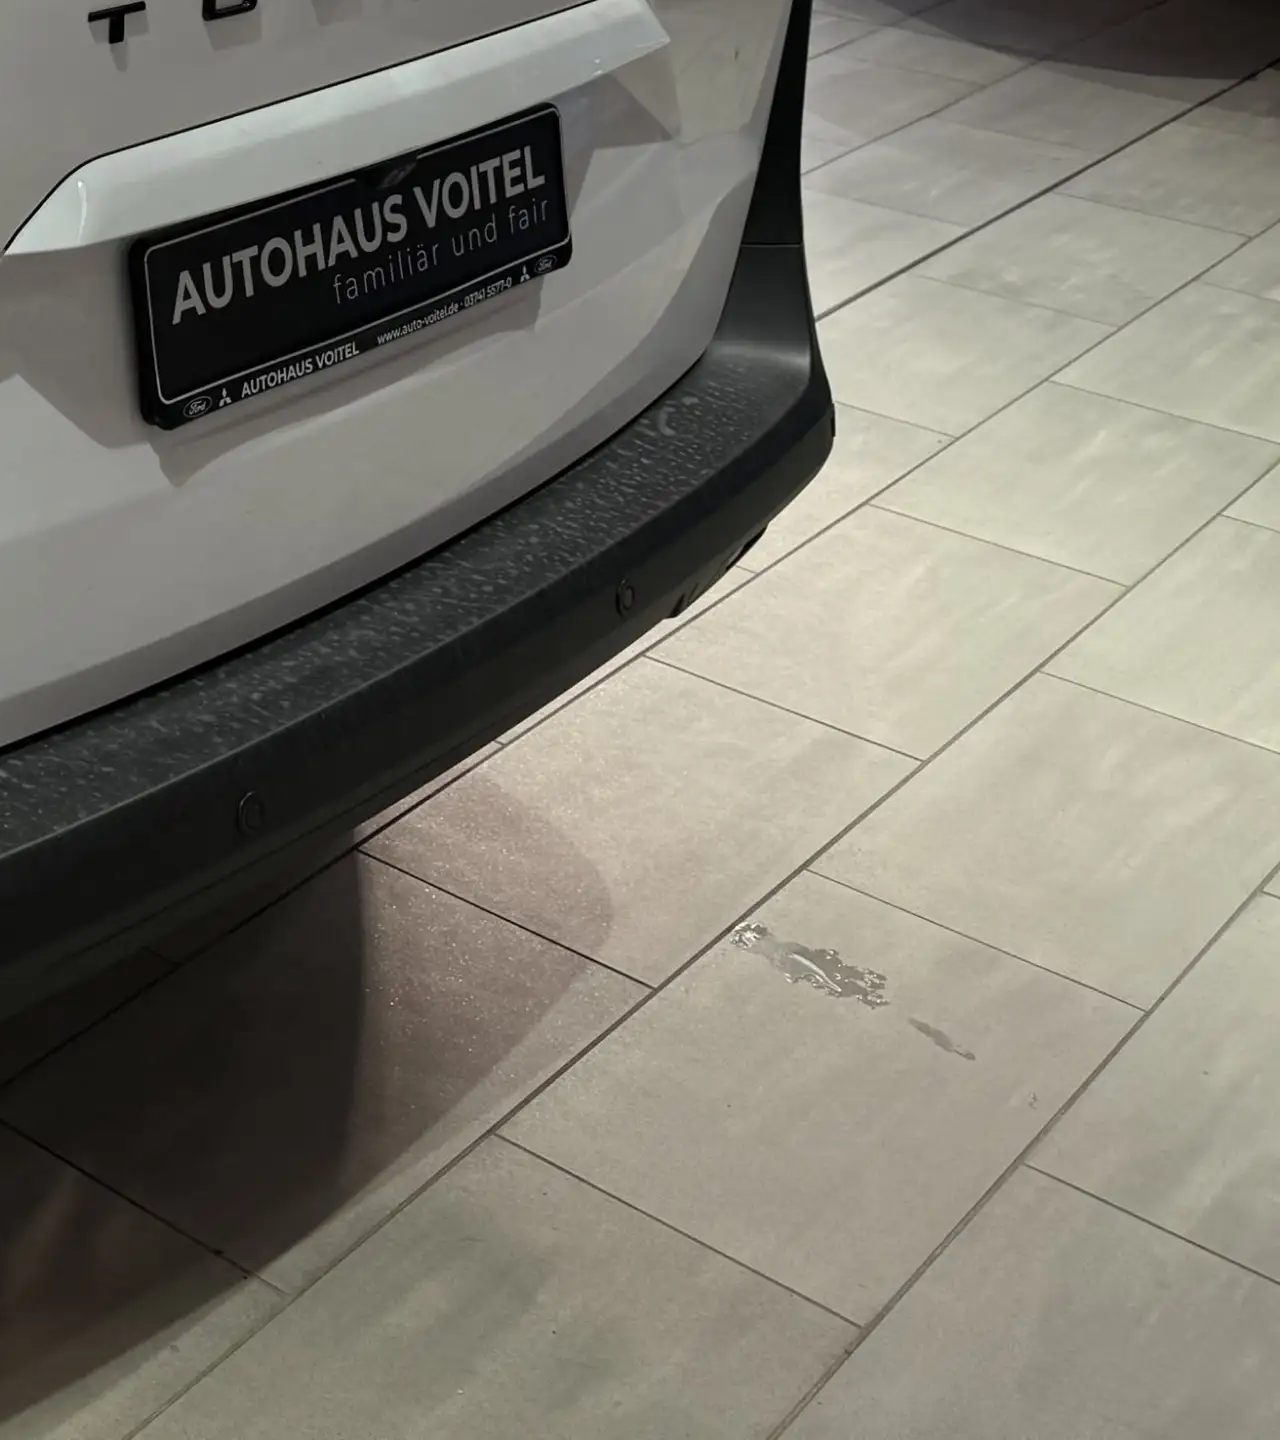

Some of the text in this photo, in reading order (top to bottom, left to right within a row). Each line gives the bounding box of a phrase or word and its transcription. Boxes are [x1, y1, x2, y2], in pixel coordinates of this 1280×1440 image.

[172, 145, 545, 326] AUTOHAUS VOITEL
[332, 196, 549, 304] familiär und fair
[241, 358, 313, 399] AUTOHAUS
[315, 341, 360, 369] VOITEL
[376, 301, 459, 345] www.auto-voitel.de
[464, 289, 486, 308] 03741
